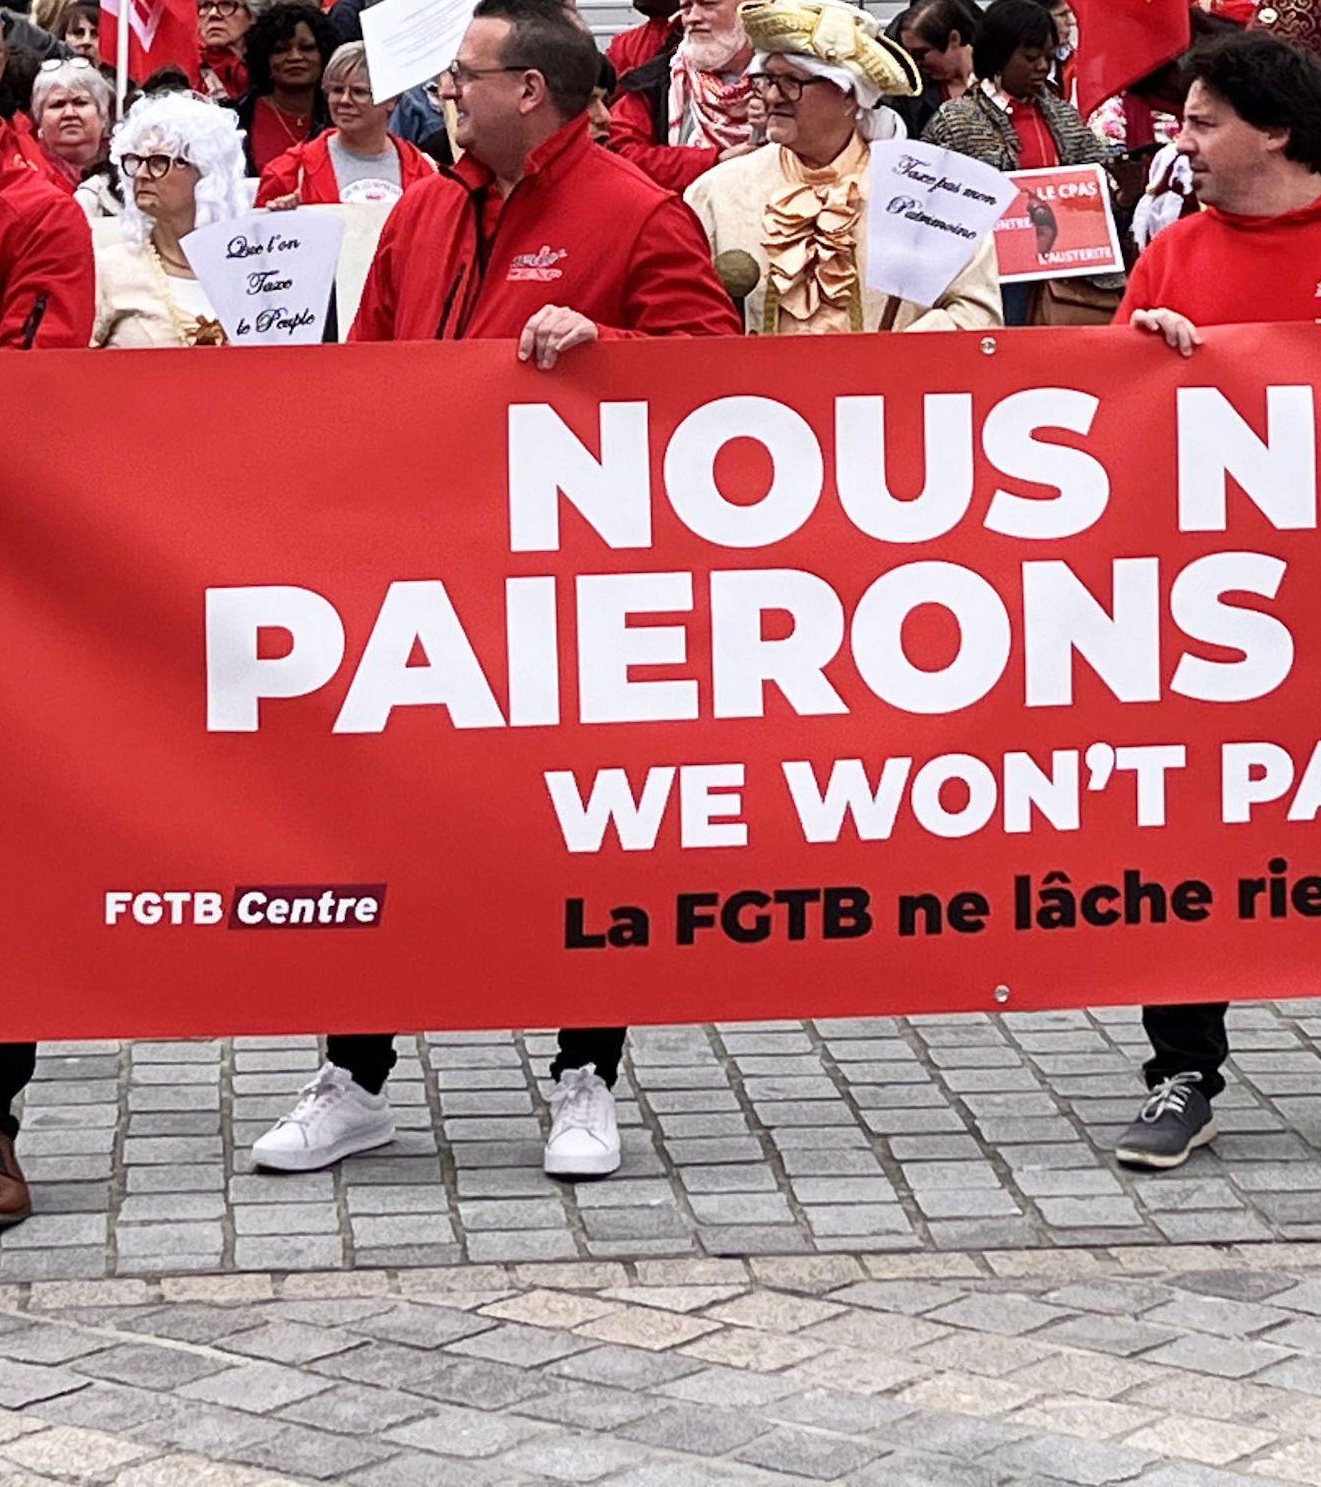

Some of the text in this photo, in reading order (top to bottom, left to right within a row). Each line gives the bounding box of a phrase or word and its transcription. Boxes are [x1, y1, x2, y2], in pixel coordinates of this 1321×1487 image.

[1036, 181, 1098, 200] LE CPAS
[885, 195, 977, 240] Patrimoine
[226, 235, 264, 259] Que
[246, 270, 293, 295] Taxe
[255, 307, 316, 336] Peuple
[508, 387, 1110, 553] NOUS
[205, 551, 1295, 734] PAIERONS
[544, 763, 748, 853] WE
[782, 742, 1186, 844] WON'T
[105, 890, 379, 925] FGTB Centre
[565, 898, 649, 950] La
[677, 885, 873, 946] FGTB
[898, 888, 990, 938] ne
[1014, 869, 1213, 930] lâche
